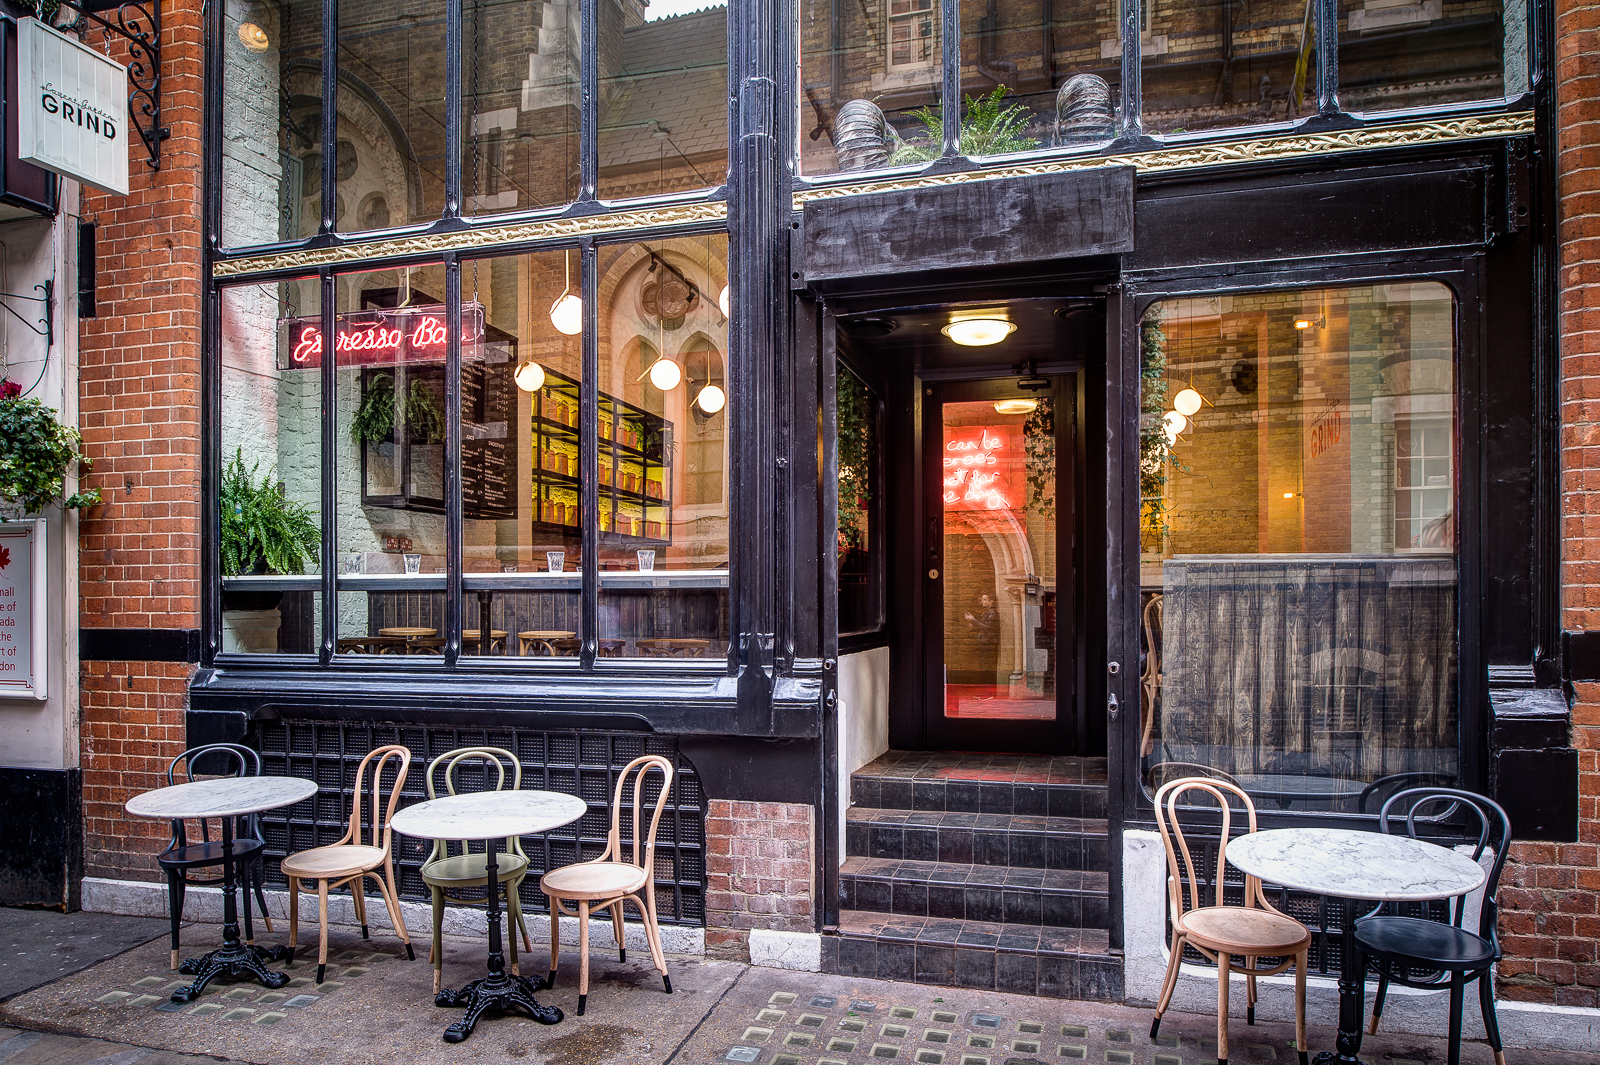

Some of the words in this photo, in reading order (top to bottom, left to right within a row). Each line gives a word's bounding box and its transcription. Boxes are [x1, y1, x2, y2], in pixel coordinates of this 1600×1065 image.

[42, 94, 116, 140] GRIND
[293, 326, 402, 362] Esresso
[412, 316, 467, 348] Ba
[946, 440, 979, 451] can
[982, 429, 1004, 450] be
[1311, 411, 1341, 459] GRIND
[971, 469, 1000, 490] for
[964, 483, 1011, 509] day
[7, 601, 17, 612] of
[7, 645, 17, 656] of
